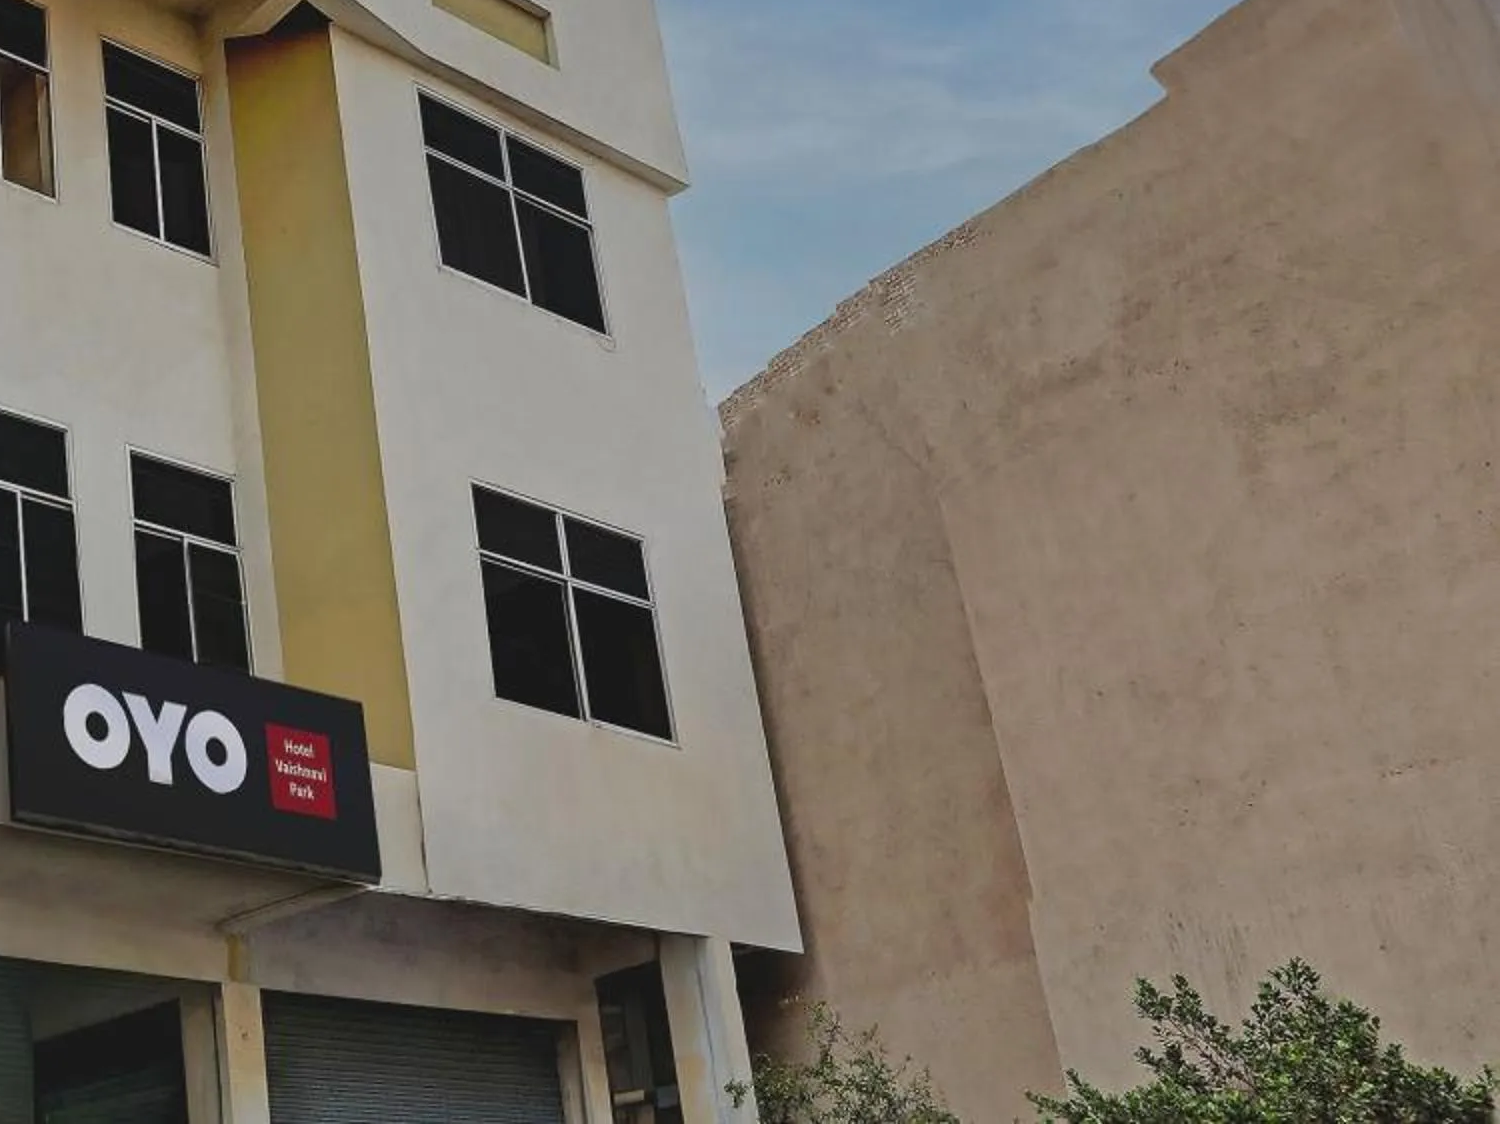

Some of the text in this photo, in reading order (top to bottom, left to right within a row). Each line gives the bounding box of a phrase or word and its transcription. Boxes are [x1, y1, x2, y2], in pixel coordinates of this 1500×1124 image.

[63, 683, 248, 794] OYO
[284, 738, 315, 758] Hotel
[275, 758, 327, 782] Vaishnavi
[289, 781, 315, 800] Park
